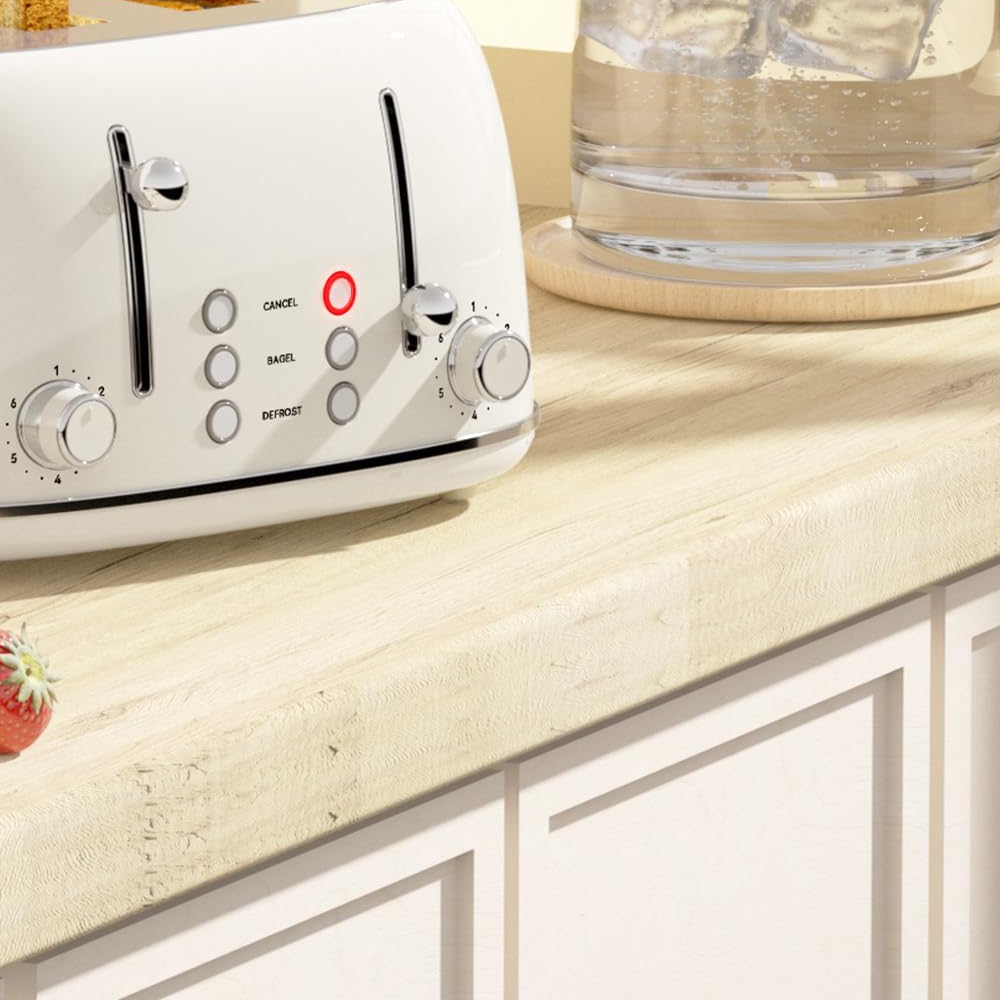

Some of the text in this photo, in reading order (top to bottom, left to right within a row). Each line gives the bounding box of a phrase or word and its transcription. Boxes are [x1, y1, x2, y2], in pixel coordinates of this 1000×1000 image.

[263, 297, 298, 311] CANCEL
[471, 301, 476, 312] 1
[438, 333, 444, 343] 6
[267, 353, 296, 365] BAGEL
[53, 364, 59, 376] 1
[98, 386, 105, 396] 2
[438, 387, 444, 398] 5
[10, 398, 17, 408] 6
[262, 405, 303, 420] DEFROST
[471, 410, 478, 420] 4
[10, 452, 17, 464] 5
[54, 474, 62, 484] 4
